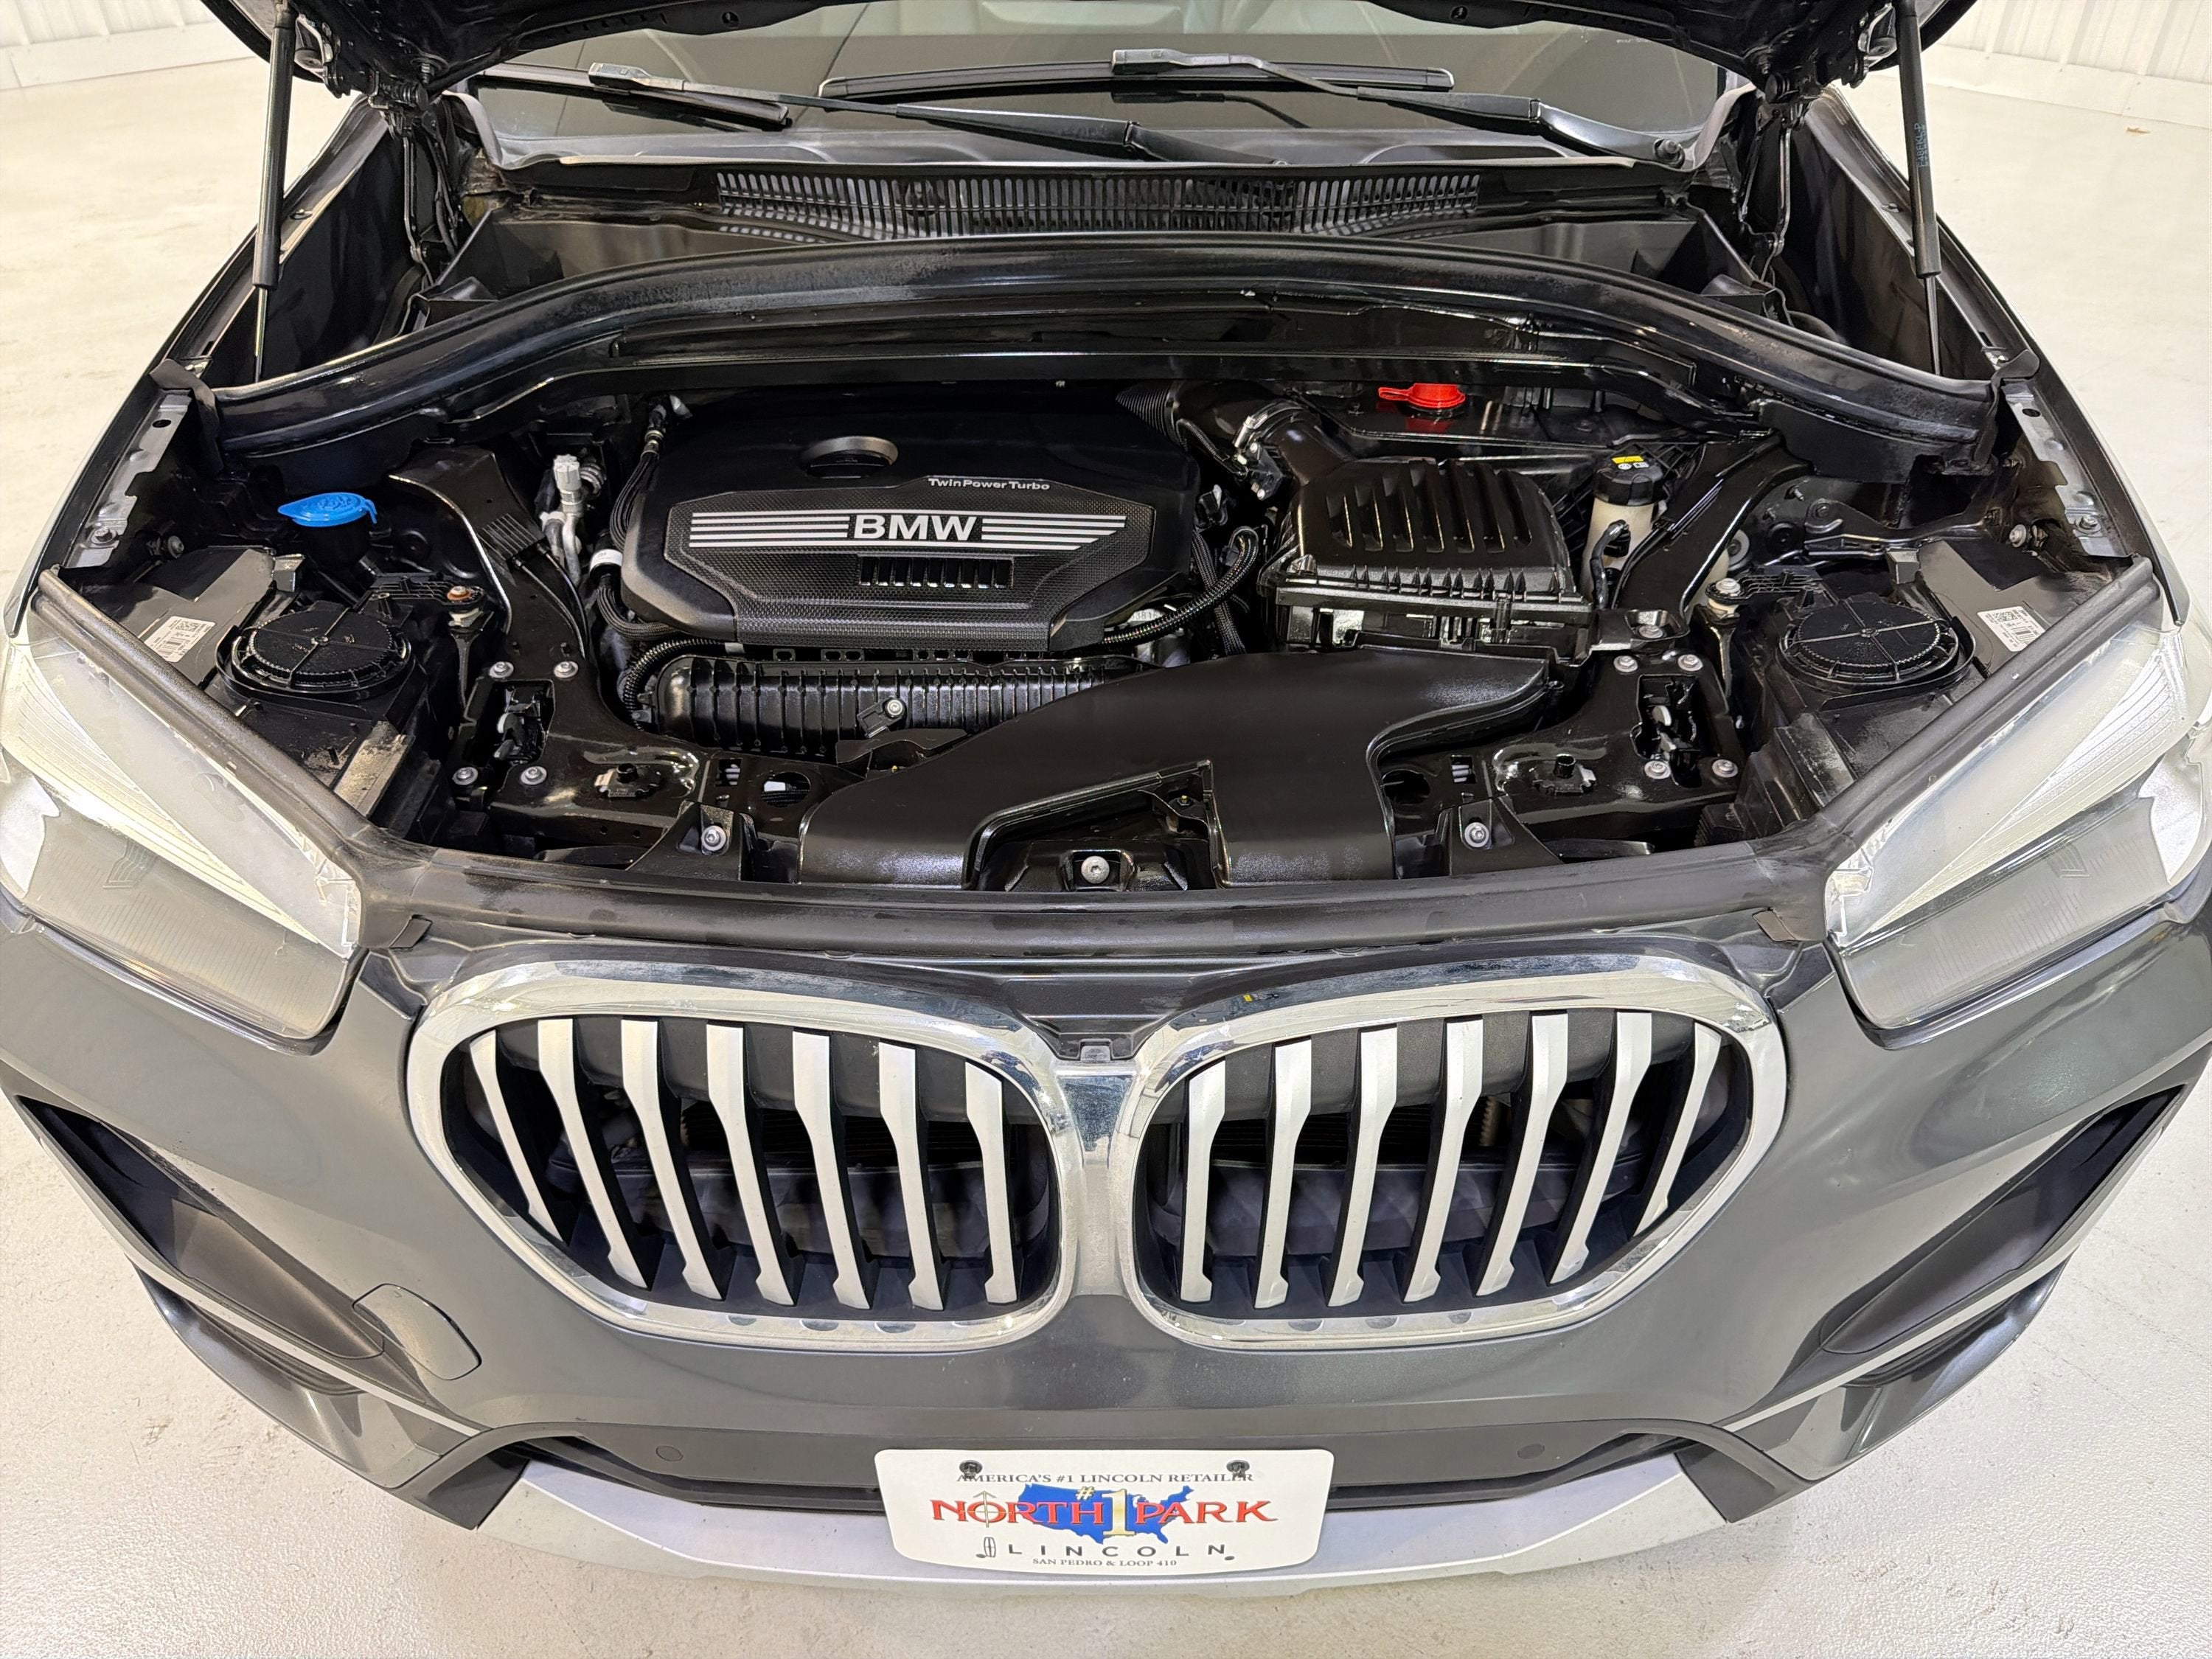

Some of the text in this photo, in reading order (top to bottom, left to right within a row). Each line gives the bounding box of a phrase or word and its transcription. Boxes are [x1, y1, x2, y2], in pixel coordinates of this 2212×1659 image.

[854, 514, 978, 540] BMW
[956, 1474, 1051, 1483] AMERICA'S
[1056, 1475, 1074, 1483] #1
[1079, 1474, 1163, 1484] LINCOLN
[930, 1499, 1105, 1525] NORTH
[1133, 1500, 1279, 1525] PARK
[1008, 1544, 1225, 1557] LINCOLN
